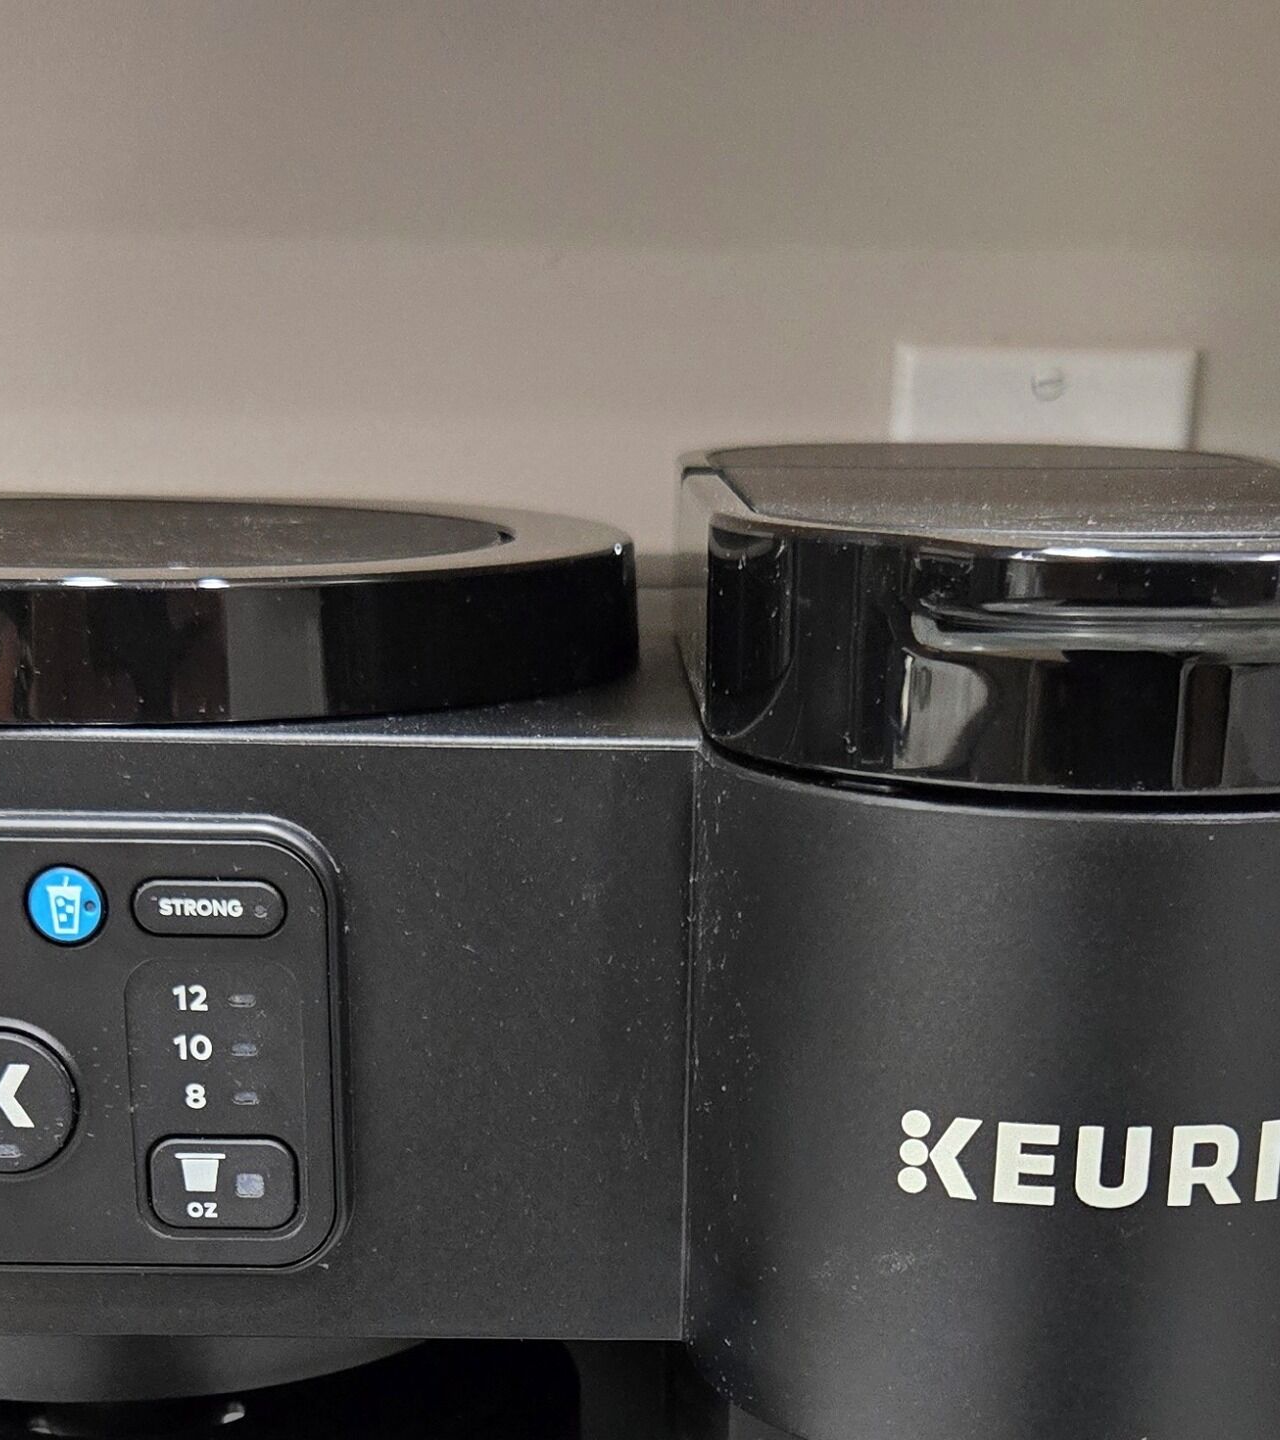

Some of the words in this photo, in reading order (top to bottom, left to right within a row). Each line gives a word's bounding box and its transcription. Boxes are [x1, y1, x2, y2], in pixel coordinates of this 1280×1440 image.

[158, 898, 244, 919] STRONG
[172, 984, 209, 1012] 12
[173, 1033, 213, 1061] 10
[185, 1082, 207, 1109] 8
[186, 1201, 219, 1219] OZ
